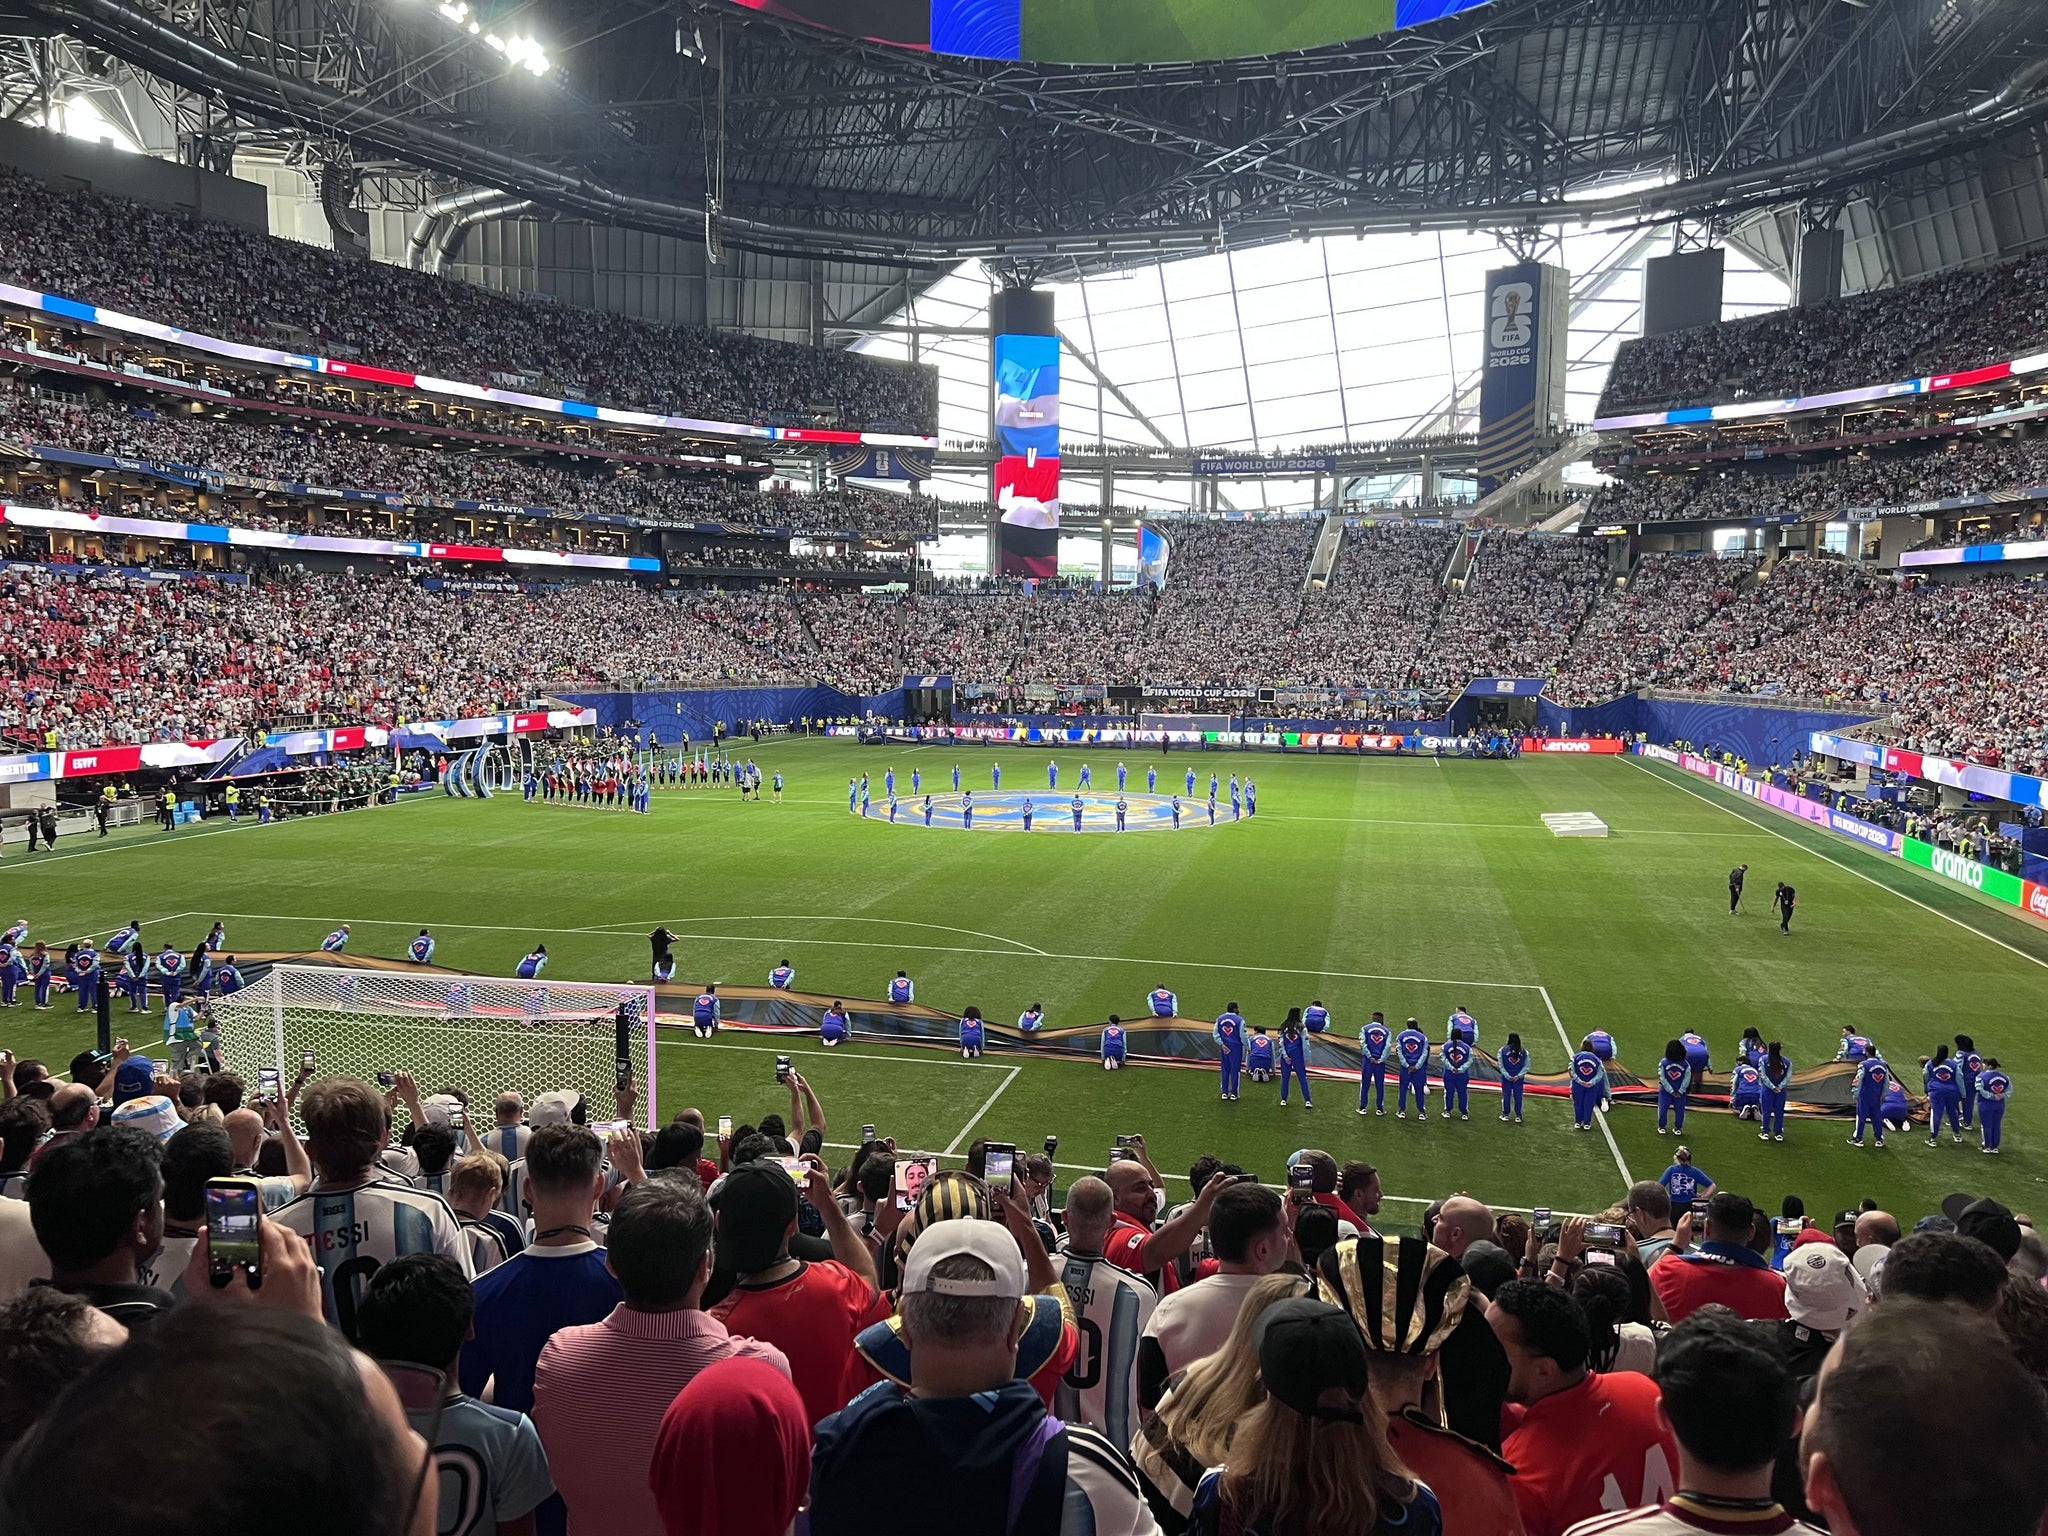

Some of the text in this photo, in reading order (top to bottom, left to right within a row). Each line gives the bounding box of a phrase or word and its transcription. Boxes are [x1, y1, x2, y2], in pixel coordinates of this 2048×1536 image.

[1502, 334, 1520, 342] FIFA
[1490, 349, 1515, 357] WORLD
[1489, 355, 1530, 367] 2026
[1027, 447, 1038, 469] V
[1201, 460, 1326, 471] FIFA WORLD CUP 2026
[478, 503, 525, 514] ATLANTA
[1878, 506, 1907, 515] WORLD
[1919, 502, 1940, 511] 2026
[1150, 688, 1256, 697] FIFA WORLD CUP 2026
[1040, 728, 1069, 741] VISA
[72, 757, 97, 769] EGYPT
[1842, 818, 1859, 835] WORLD
[1858, 824, 1869, 839] CUP
[1867, 829, 1888, 846] 2026
[1931, 847, 1983, 889] aramco
[322, 1204, 346, 1216] 1893
[1070, 1266, 1085, 1276] 1893
